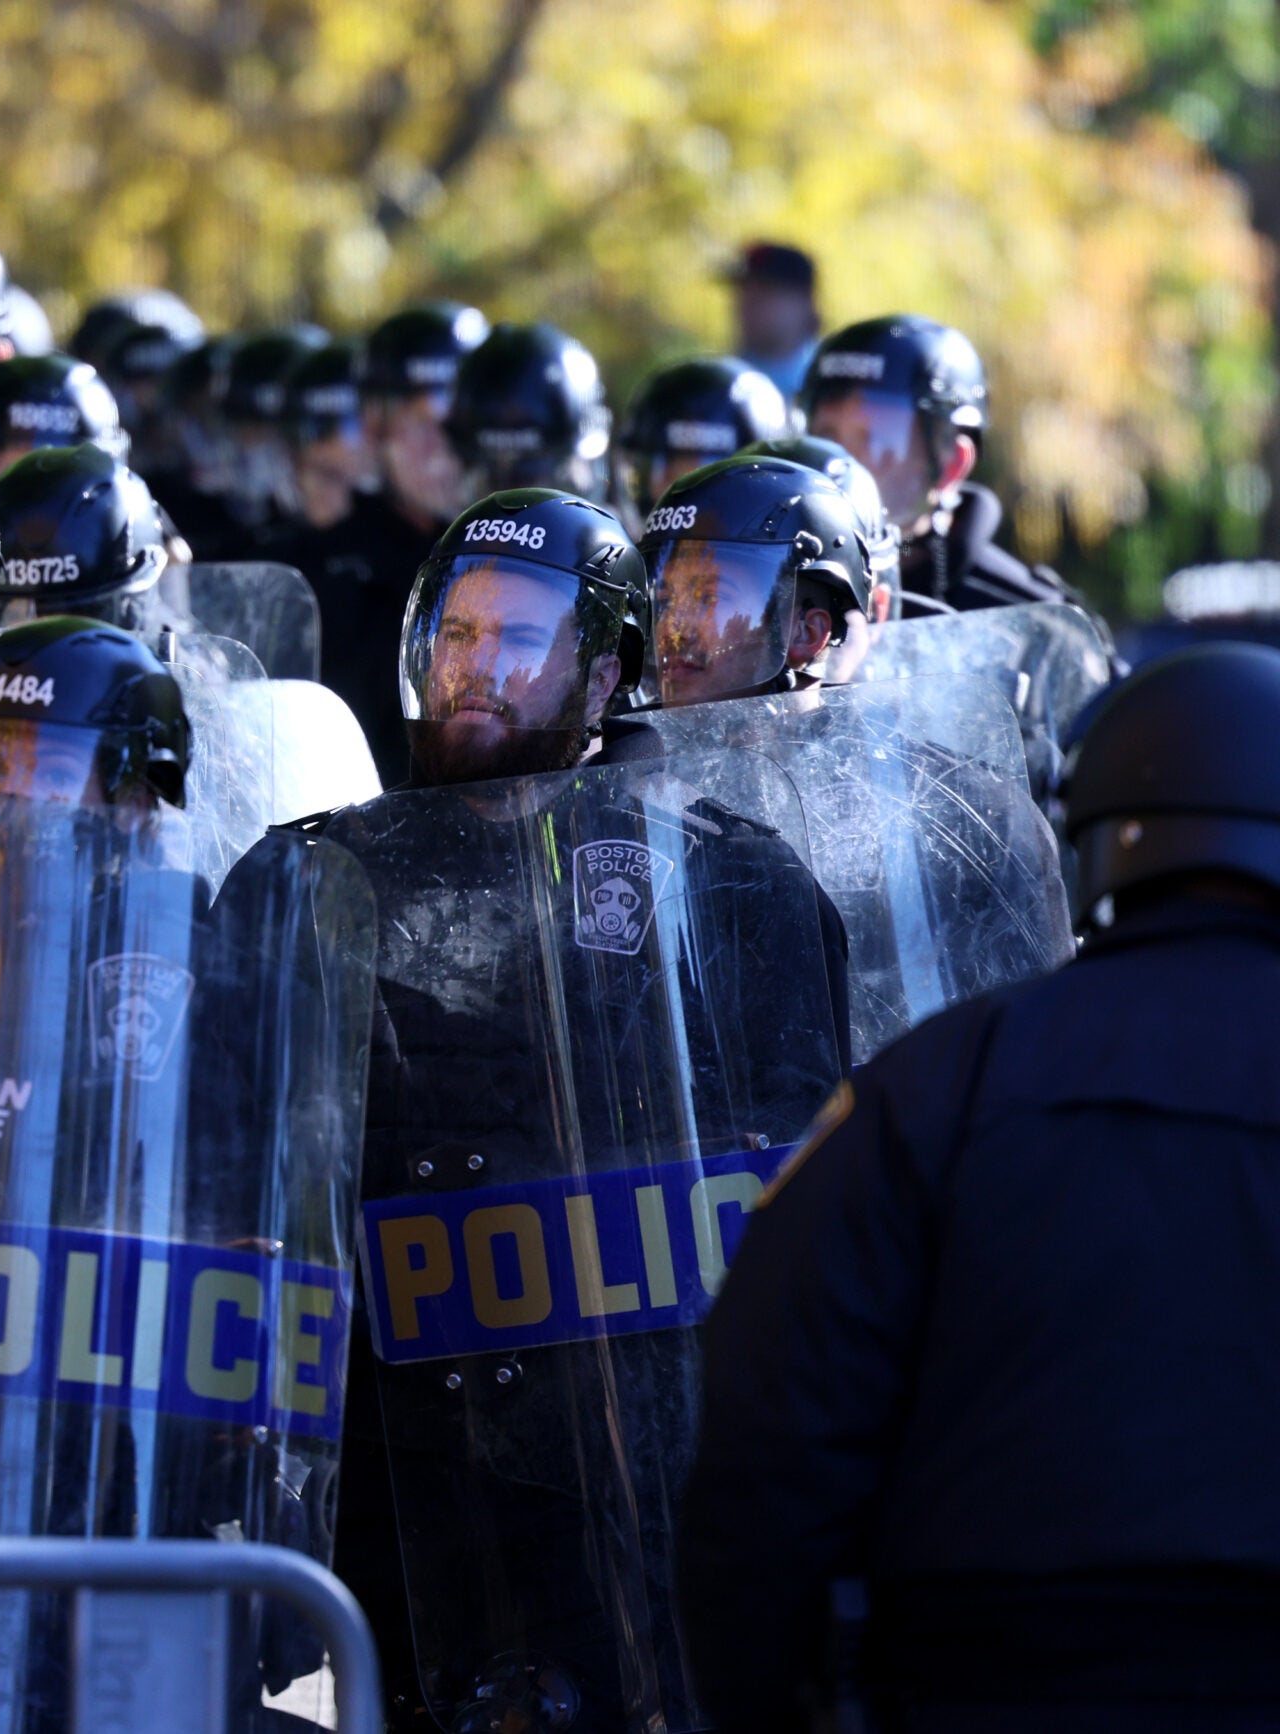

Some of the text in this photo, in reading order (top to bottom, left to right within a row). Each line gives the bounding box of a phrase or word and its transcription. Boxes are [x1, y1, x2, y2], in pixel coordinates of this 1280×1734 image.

[464, 519, 546, 549] 135948
[5, 554, 80, 585] 136725
[585, 846, 661, 871] BOSTON
[587, 860, 655, 882] POLICE
[378, 1171, 767, 1342] POLIC
